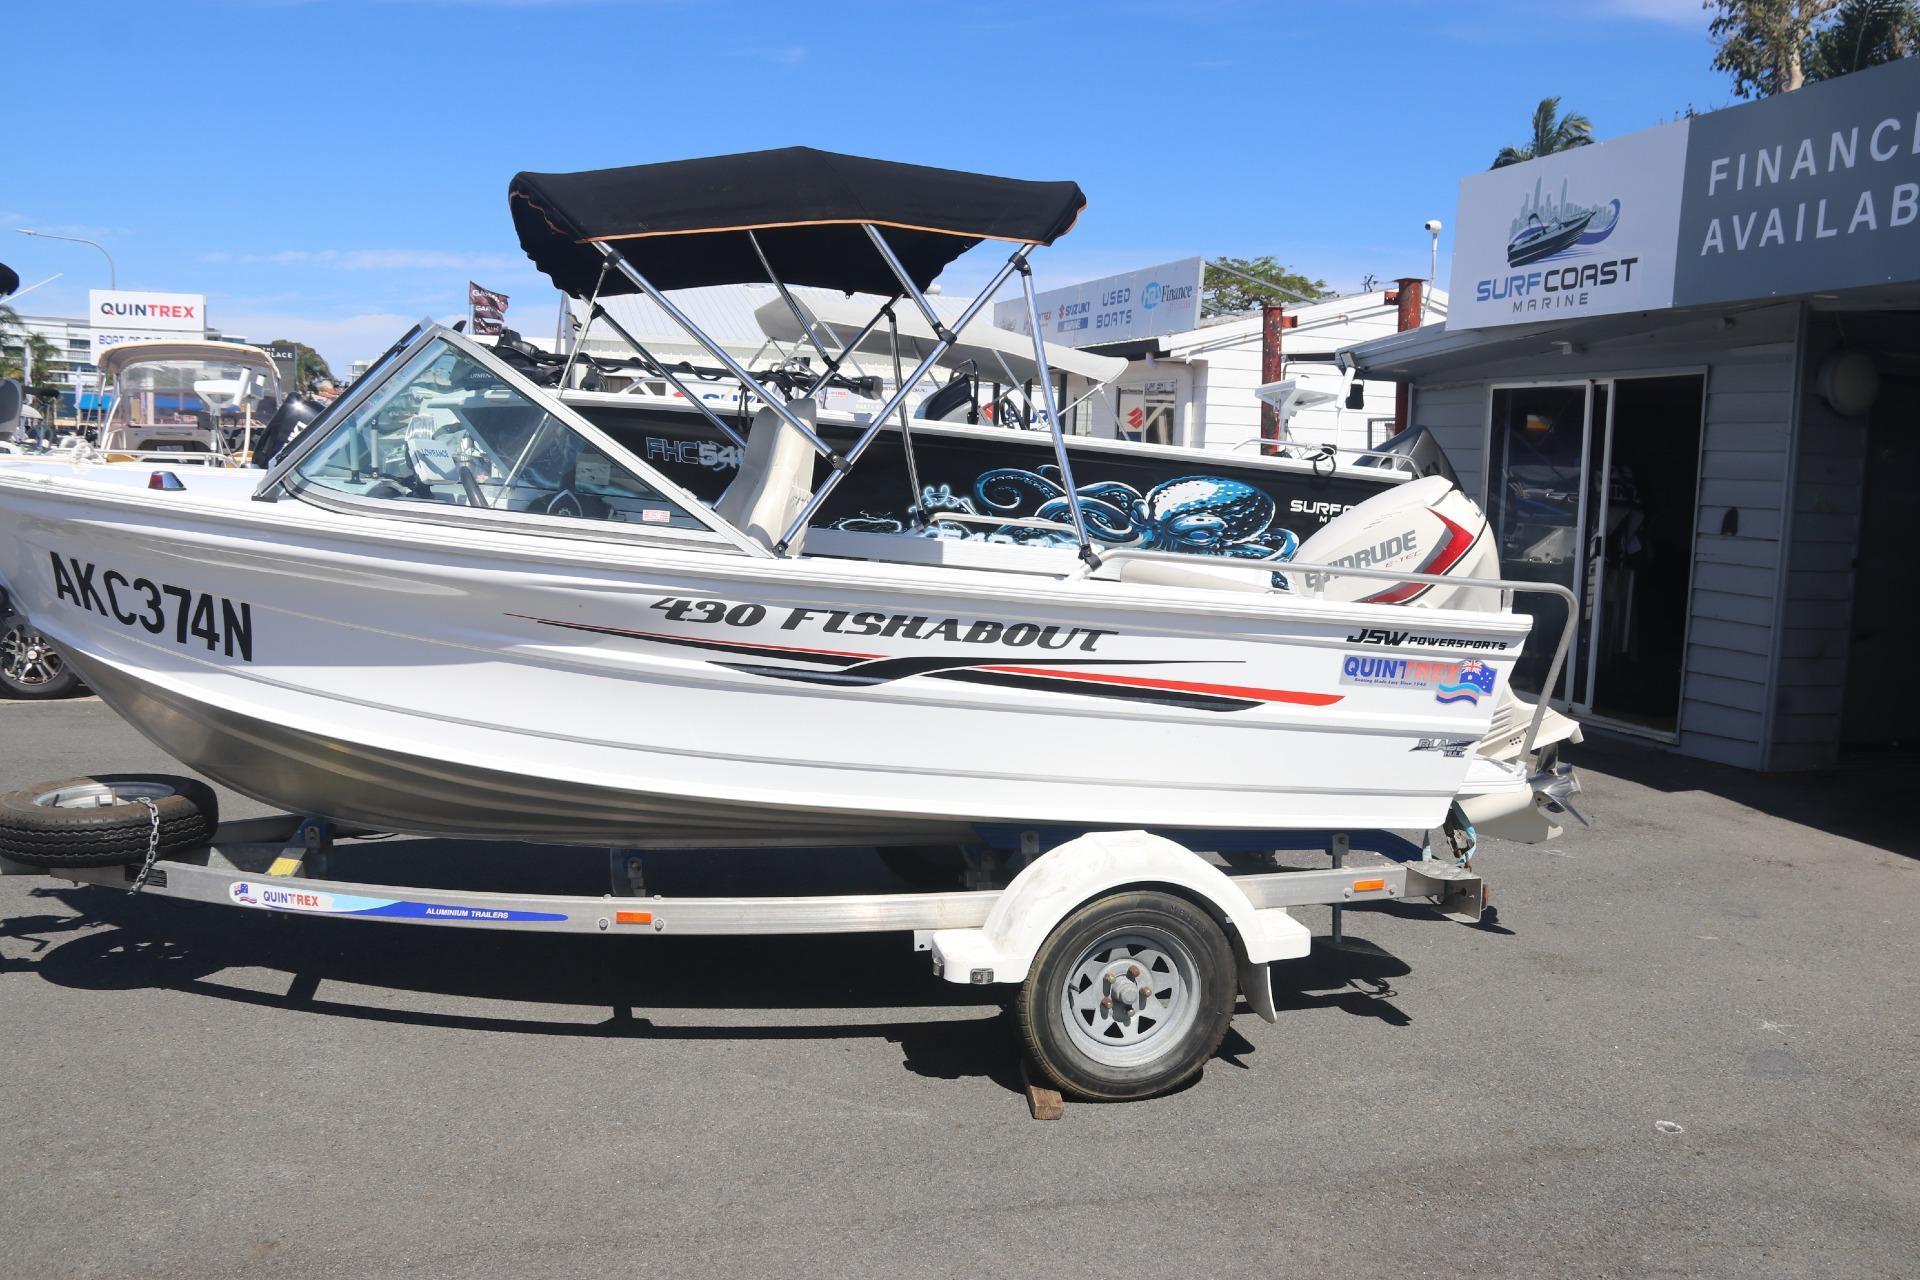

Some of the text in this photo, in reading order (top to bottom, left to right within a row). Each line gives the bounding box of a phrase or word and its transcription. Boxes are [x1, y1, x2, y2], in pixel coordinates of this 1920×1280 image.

[1701, 183, 1920, 256] AVAILAB
[1102, 288, 1131, 307] USED
[1161, 285, 1192, 302] Finance
[1513, 293, 1589, 312] MARINE
[101, 302, 194, 318] QUINTREX
[1065, 302, 1090, 316] SUZUKI
[1096, 310, 1132, 328] BOATS
[99, 335, 124, 344] BOAT
[50, 551, 252, 662] AKC374N
[650, 597, 1119, 652] 430 FISHABOUT
[1346, 629, 1508, 650] JSW POWERSPORTS
[263, 891, 319, 907] QUINTREX
[426, 907, 509, 919] ALUMINIUM TRAILERS
